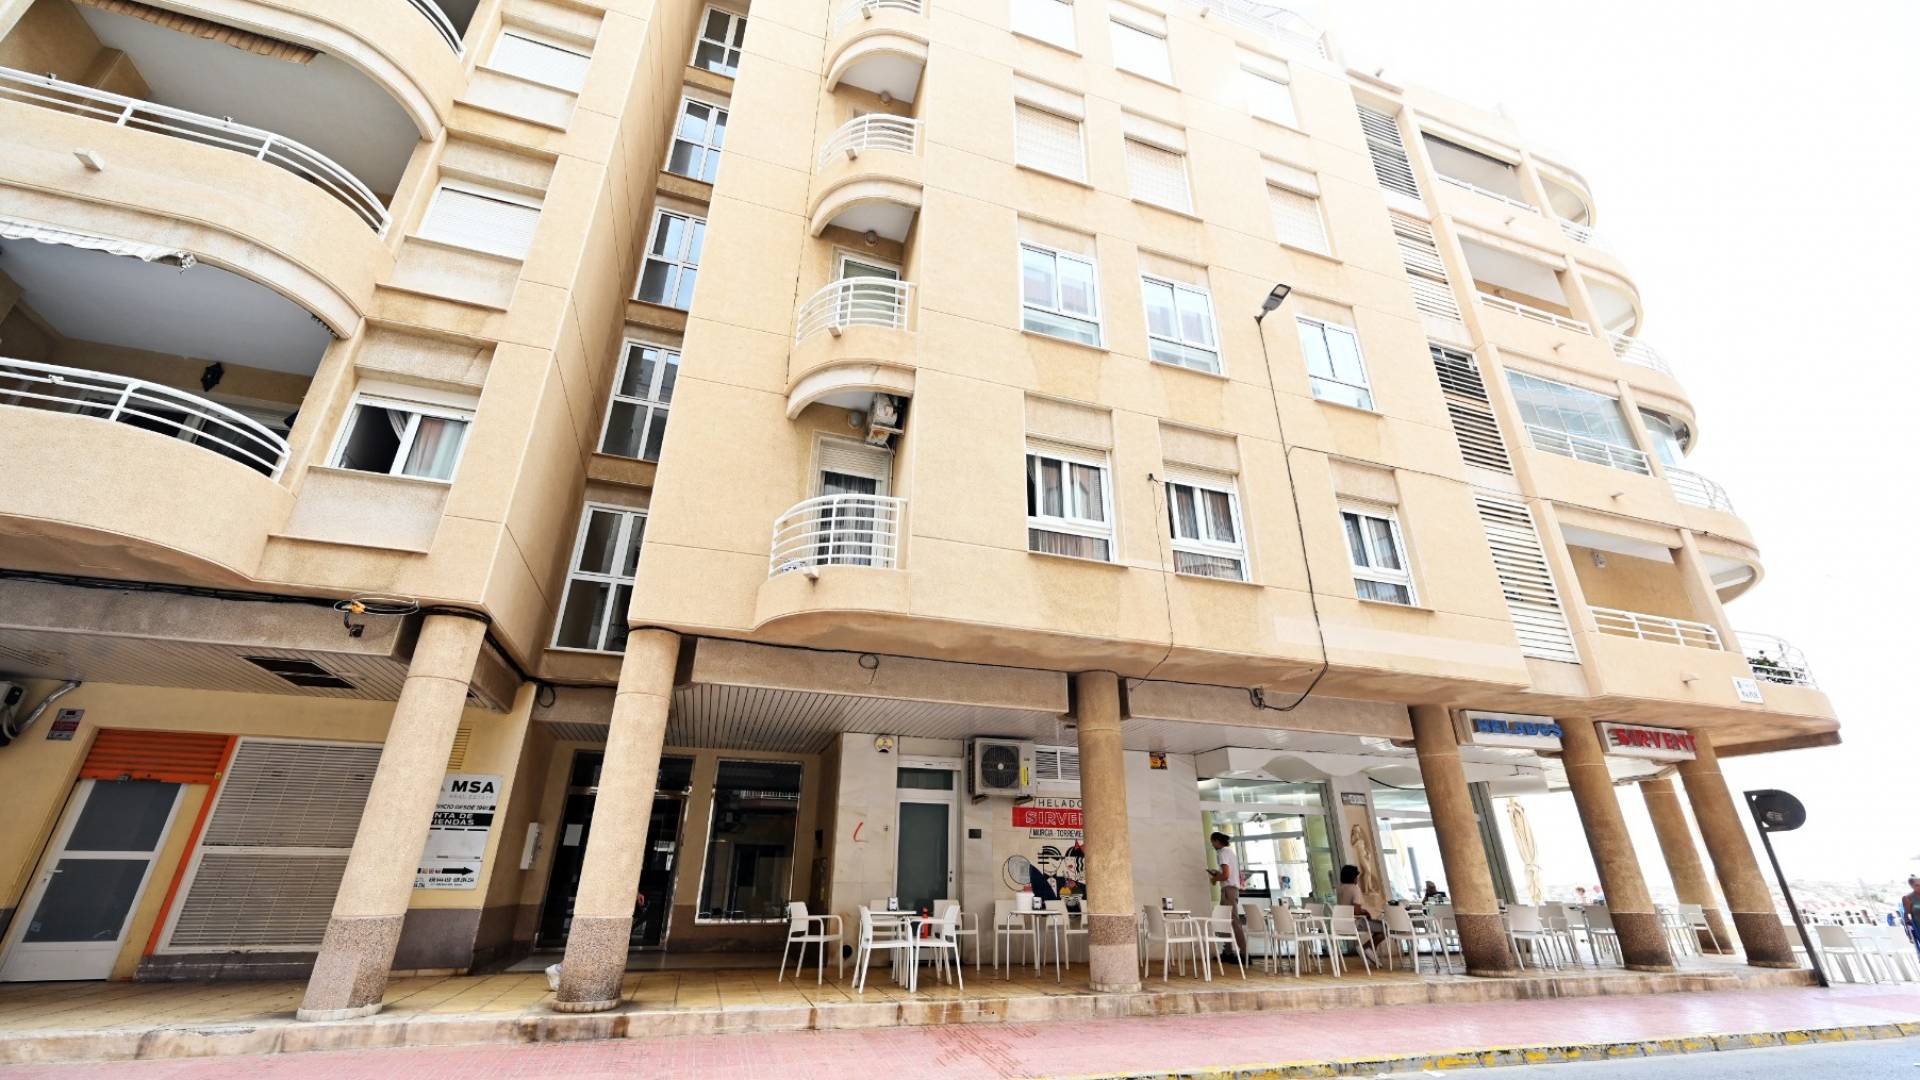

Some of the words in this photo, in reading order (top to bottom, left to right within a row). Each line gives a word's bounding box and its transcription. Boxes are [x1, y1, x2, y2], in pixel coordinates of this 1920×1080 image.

[1476, 719, 1564, 738] HELADOS
[1614, 727, 1697, 753] SIRVENT
[451, 780, 495, 793] MSA
[1038, 799, 1083, 808] HELADO
[1025, 811, 1083, 825] SIRVE
